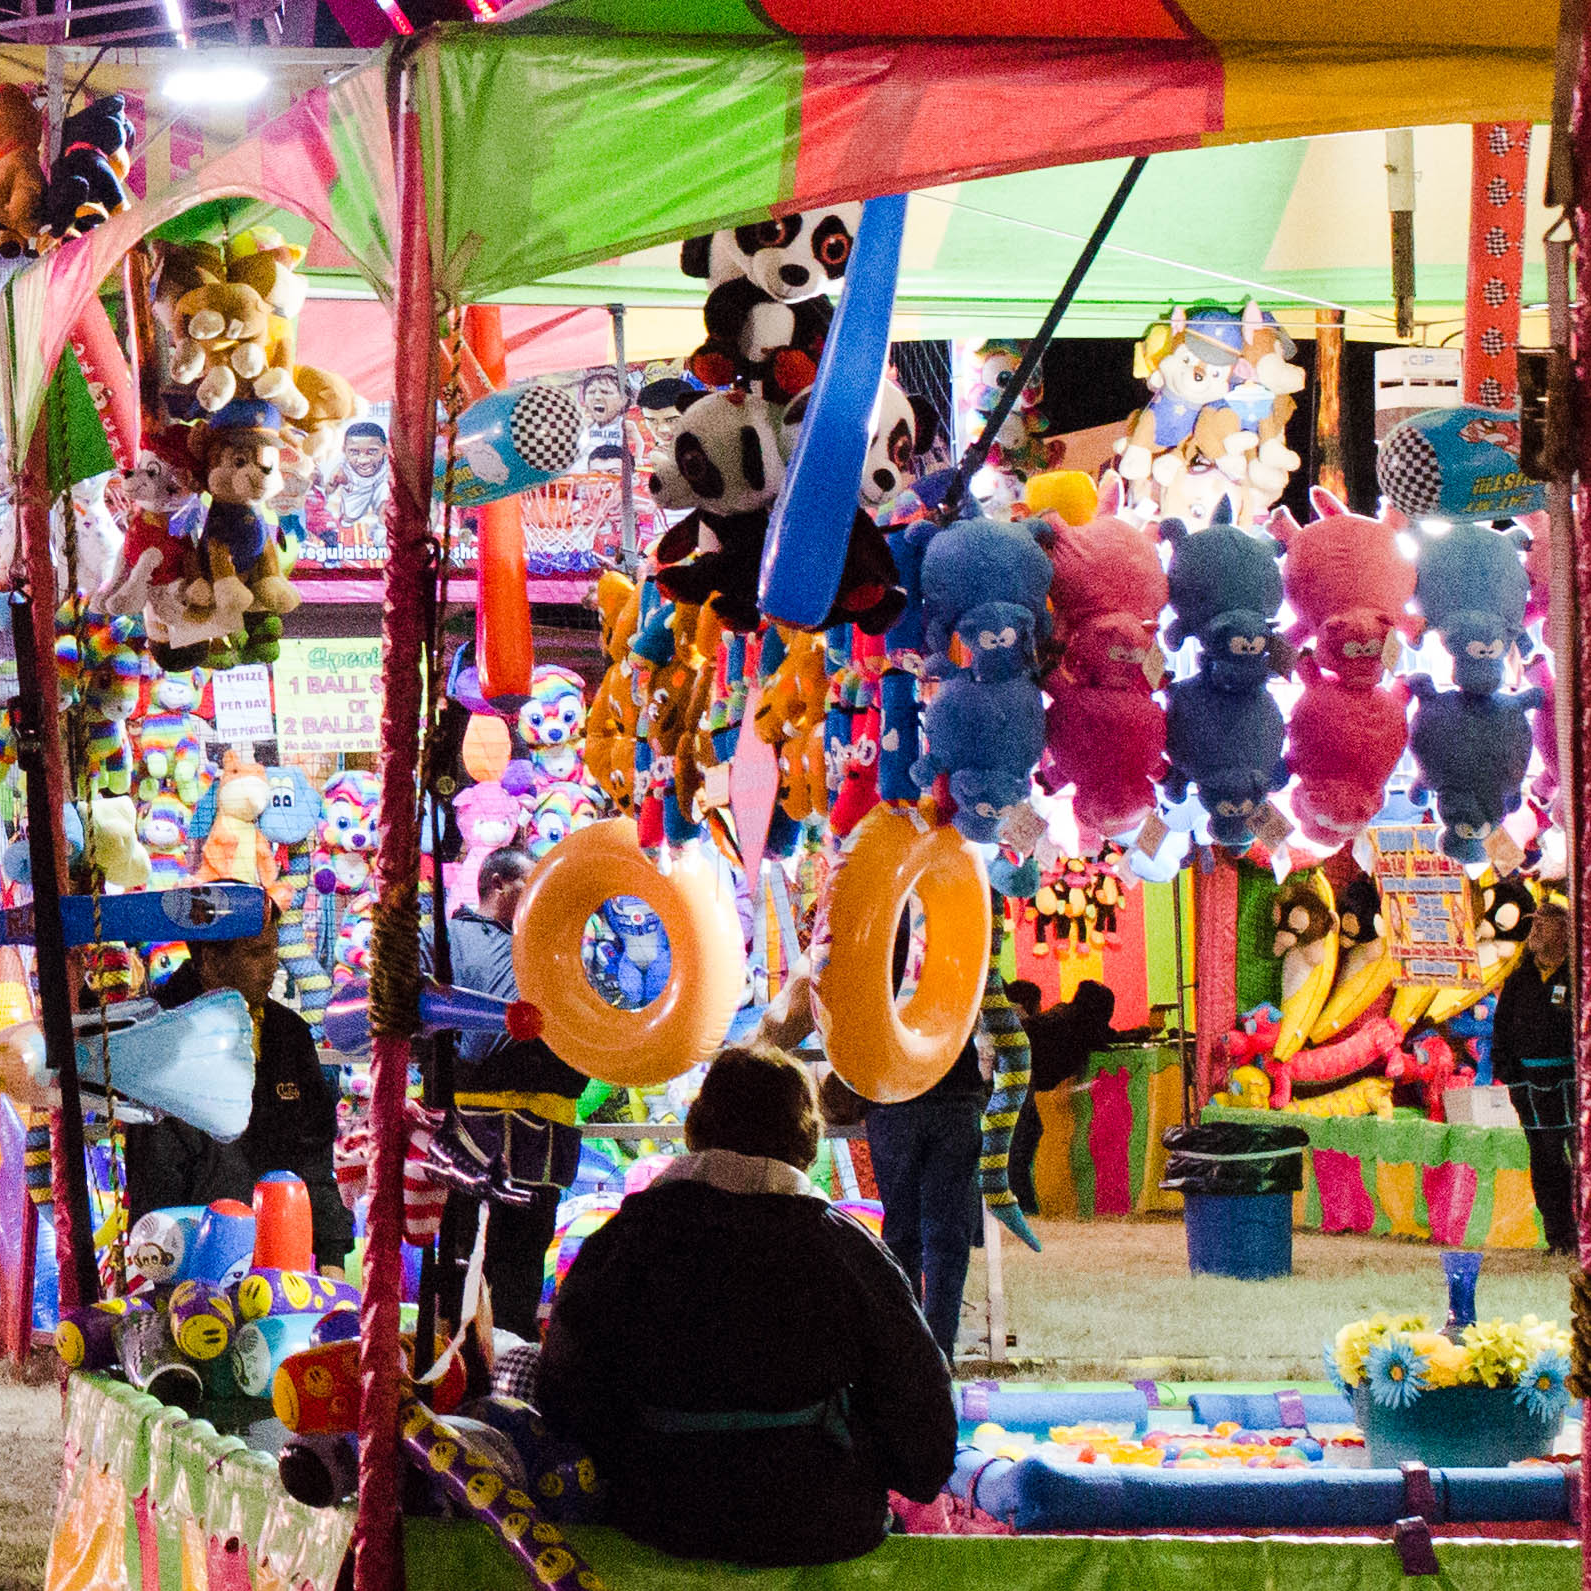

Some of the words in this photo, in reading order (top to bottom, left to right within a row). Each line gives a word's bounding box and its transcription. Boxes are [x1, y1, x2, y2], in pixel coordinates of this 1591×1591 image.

[298, 543, 389, 563] regulation
[226, 671, 264, 683] PRIZE
[306, 675, 367, 695] BALL
[219, 699, 243, 711] PER
[244, 698, 268, 709] DAY
[283, 718, 297, 735] 2
[302, 716, 375, 734] BALLS
